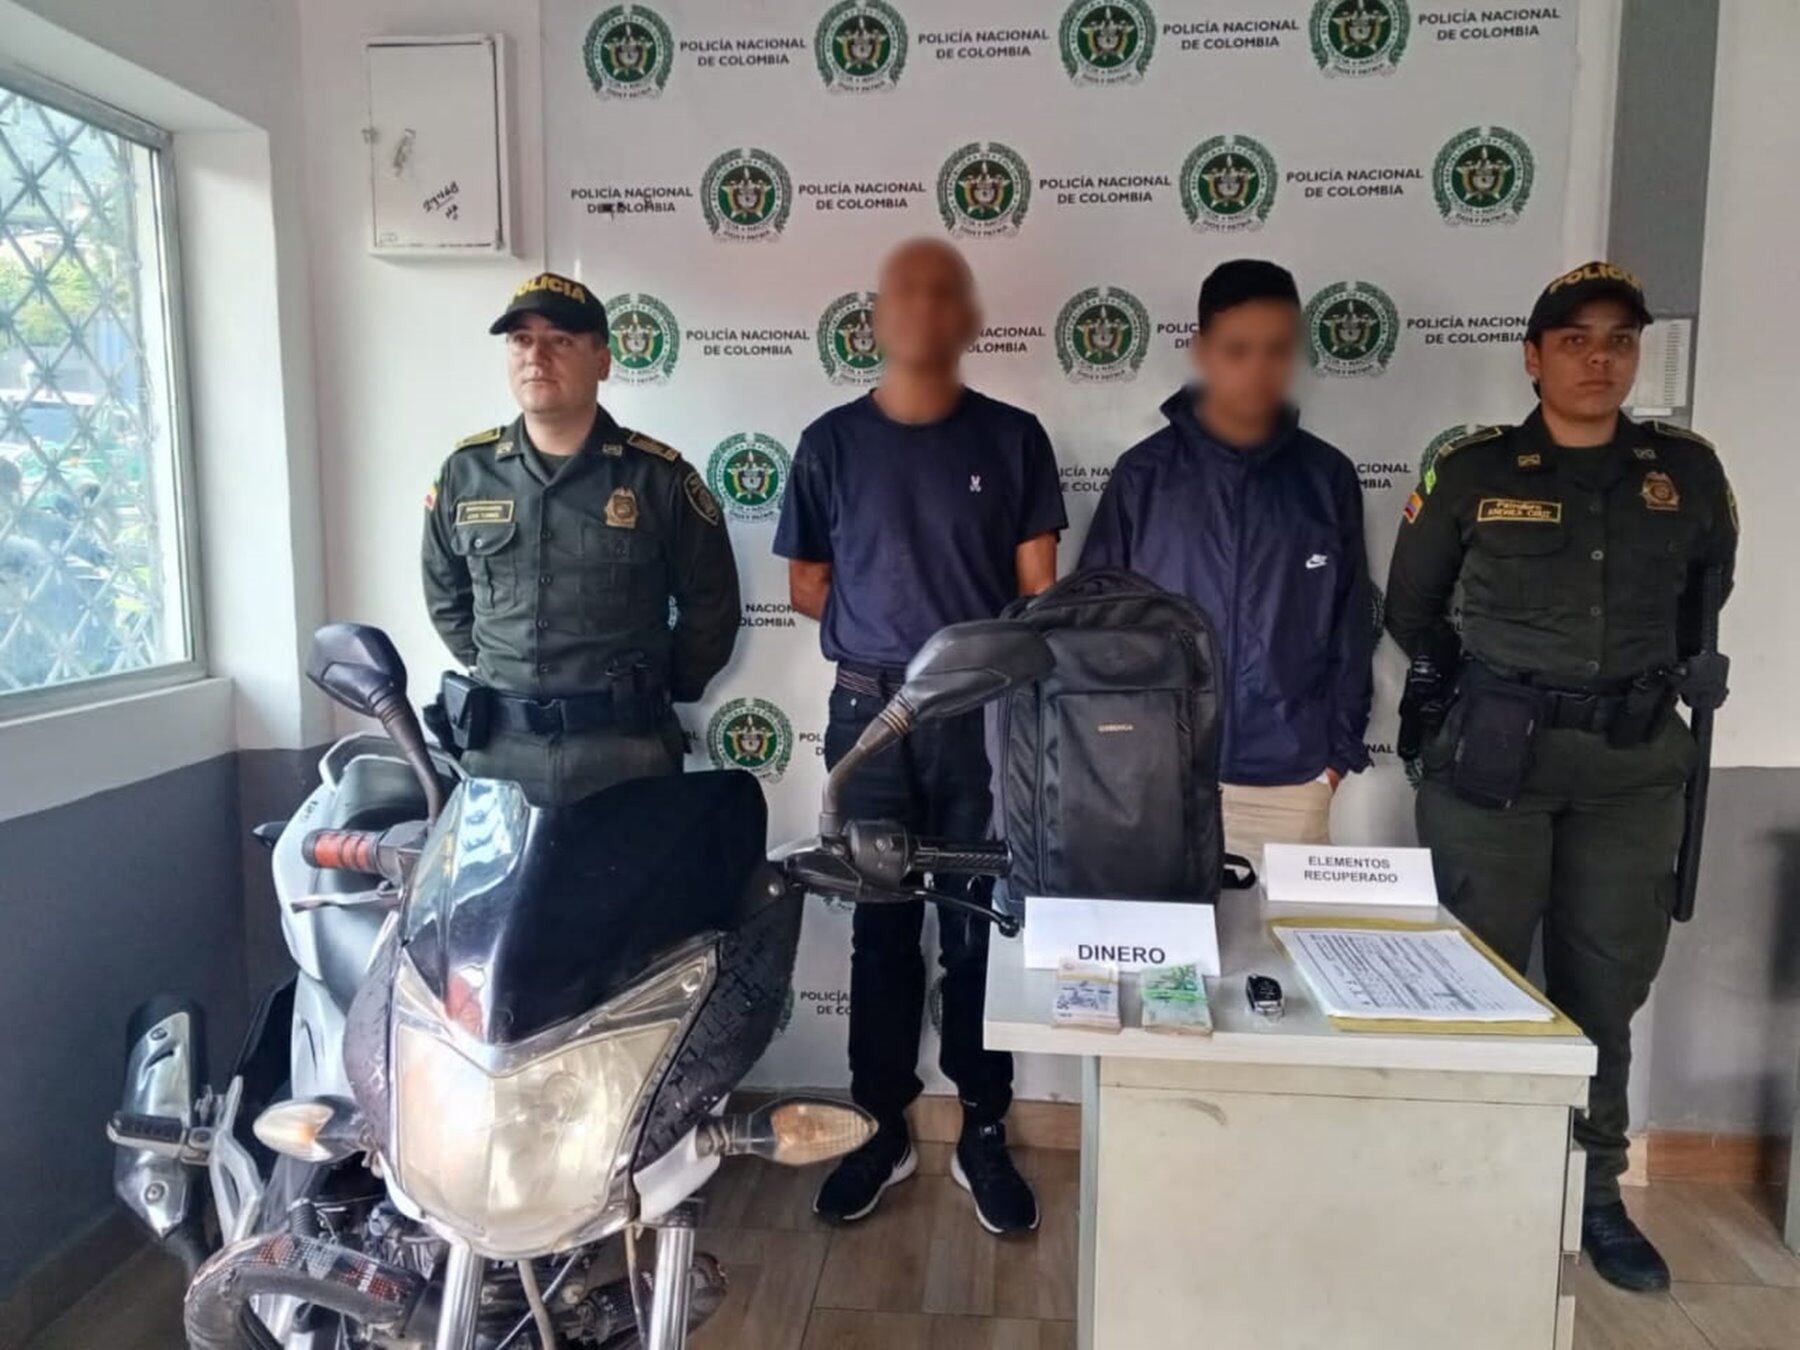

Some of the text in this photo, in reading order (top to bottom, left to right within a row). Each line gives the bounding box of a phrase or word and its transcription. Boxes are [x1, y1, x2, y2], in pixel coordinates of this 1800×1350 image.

[1418, 7, 1560, 25] POLICÍA NACIONAL
[1162, 19, 1299, 36] POLICÍA NACIONAL
[1436, 24, 1540, 41] DE COLOMBIA
[917, 29, 1049, 45] POLICÍA NACIONAL
[1180, 36, 1280, 51] DE COLOMBIA
[679, 38, 806, 52] POLICÍA NACIONAL
[935, 45, 1031, 60] DE COLOMBIA
[697, 53, 790, 67] DE COLOMBIA
[1039, 175, 1171, 190] POLICÍA NACIONAL
[1286, 168, 1423, 183] POLICÍA NACIONAL
[570, 186, 693, 199] POLICÍA NACIONAL
[798, 181, 926, 196] POLICÍA NACIONAL
[1304, 184, 1404, 198] DE COLOMBIA
[815, 197, 908, 211] DE COLOMBIA
[1057, 191, 1153, 205] DE COLOMBIA
[1156, 322, 1199, 334] POLIC
[1406, 316, 1527, 330] POLICÍA NACION
[685, 327, 810, 341] POLICÍA NACIONAL
[1424, 332, 1525, 345] DE COLOMBIA
[703, 344, 793, 356] DE COLOMBIA
[967, 341, 1028, 354] OLOMBIA
[1355, 463, 1411, 474] CIONAL
[745, 602, 796, 614] NACION
[739, 617, 797, 628] OLOMBIA
[1307, 855, 1392, 870] ELEMENTOS
[1303, 869, 1399, 884] RECUPERADO
[1077, 943, 1167, 965] DINERO
[816, 1004, 834, 1016] DE
